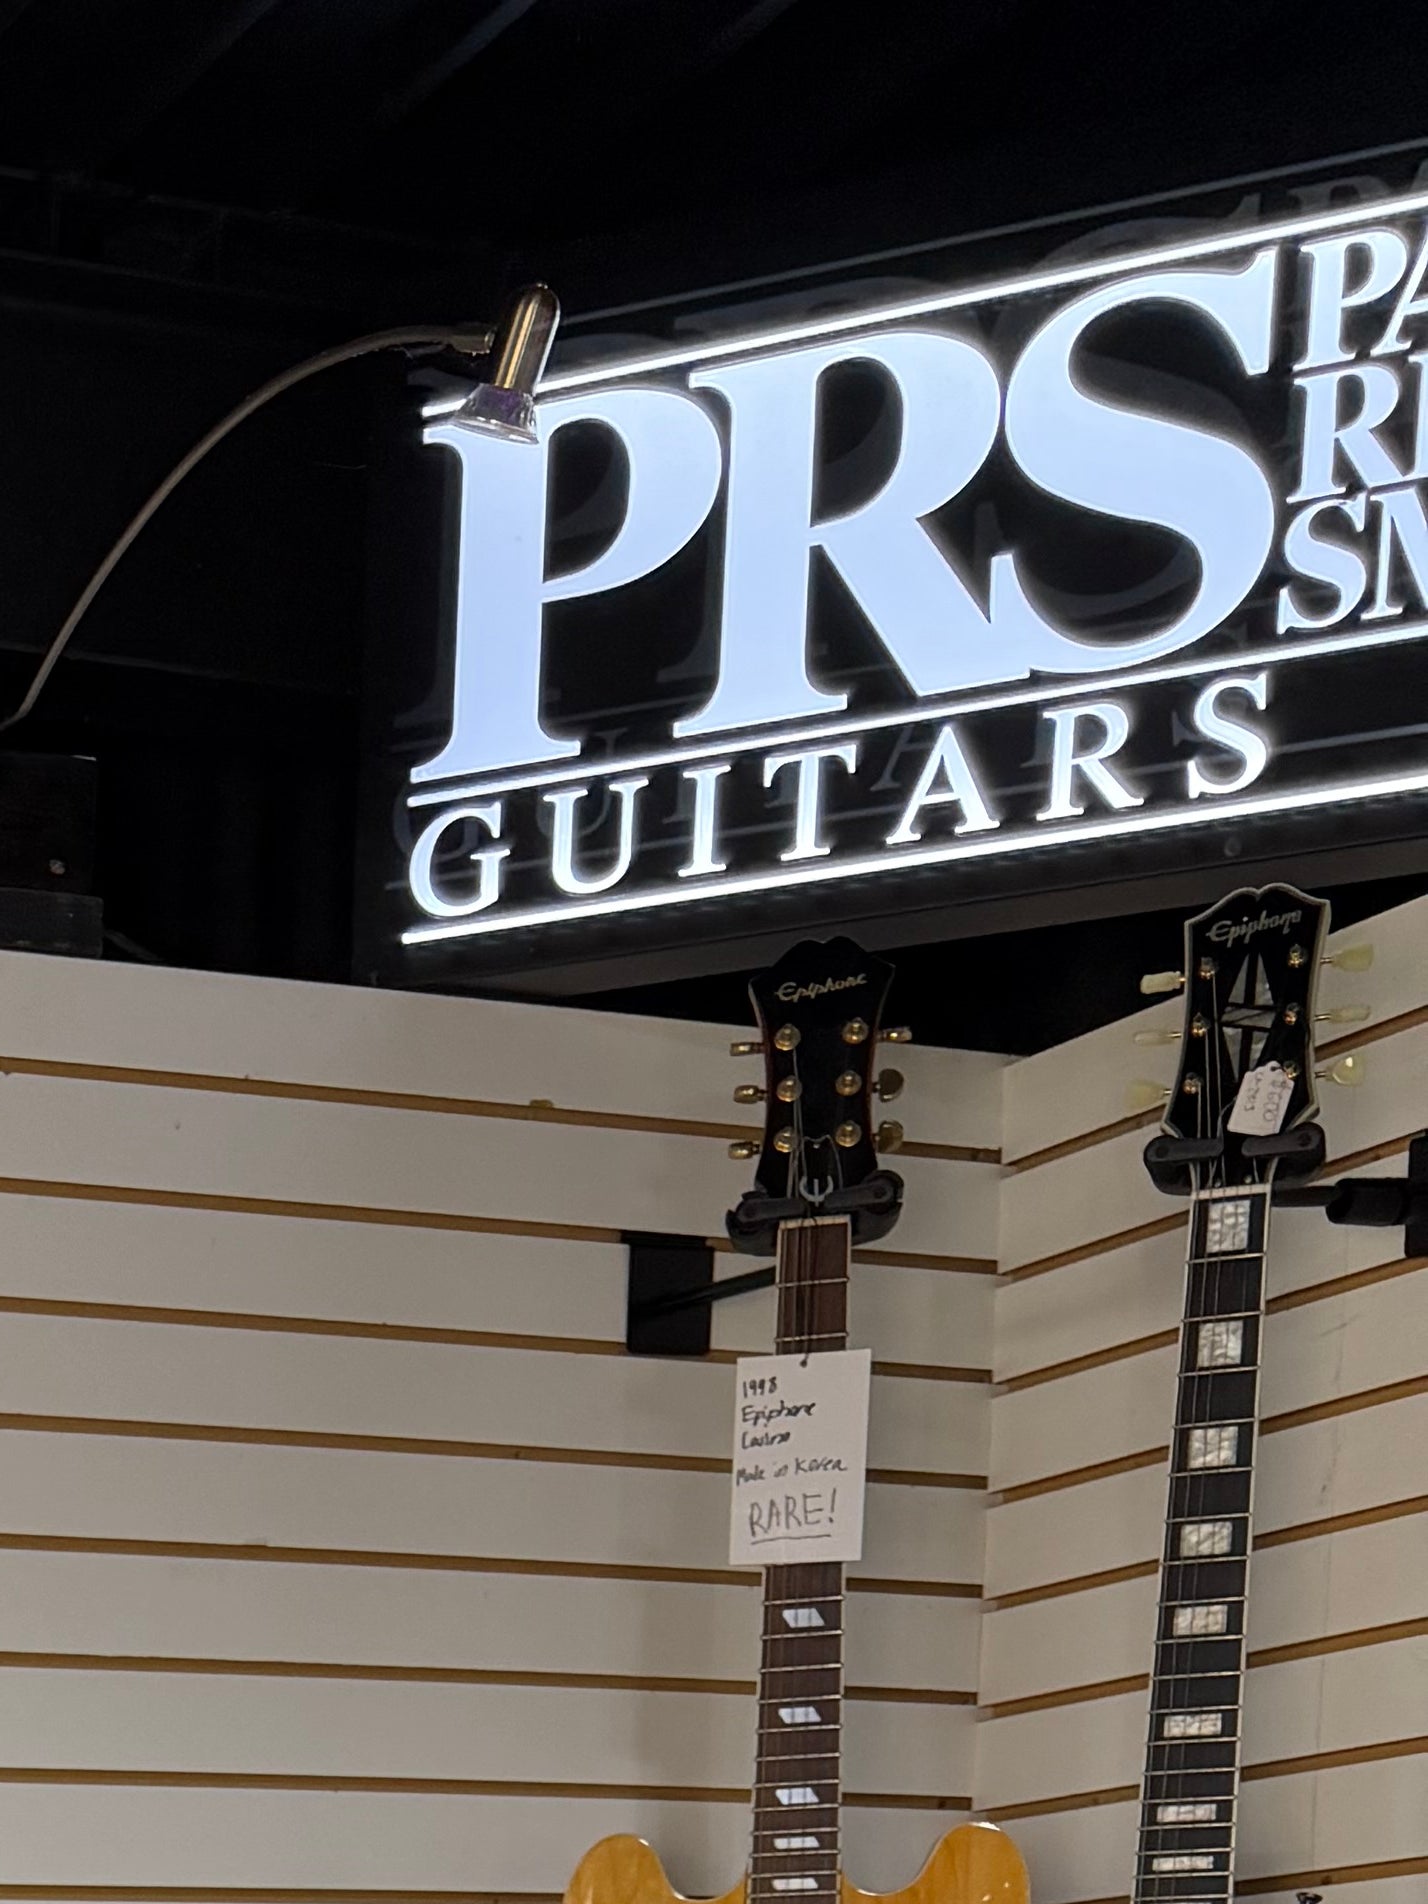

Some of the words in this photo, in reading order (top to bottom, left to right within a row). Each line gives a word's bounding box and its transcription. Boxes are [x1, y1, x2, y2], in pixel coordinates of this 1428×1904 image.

[409, 250, 1277, 784] PRS
[407, 672, 1270, 921] GUITARS
[1205, 910, 1302, 948] Epiphone
[774, 973, 867, 1003] Epiphone
[794, 1456, 848, 1474] Korea
[748, 1488, 837, 1537] RARE!
